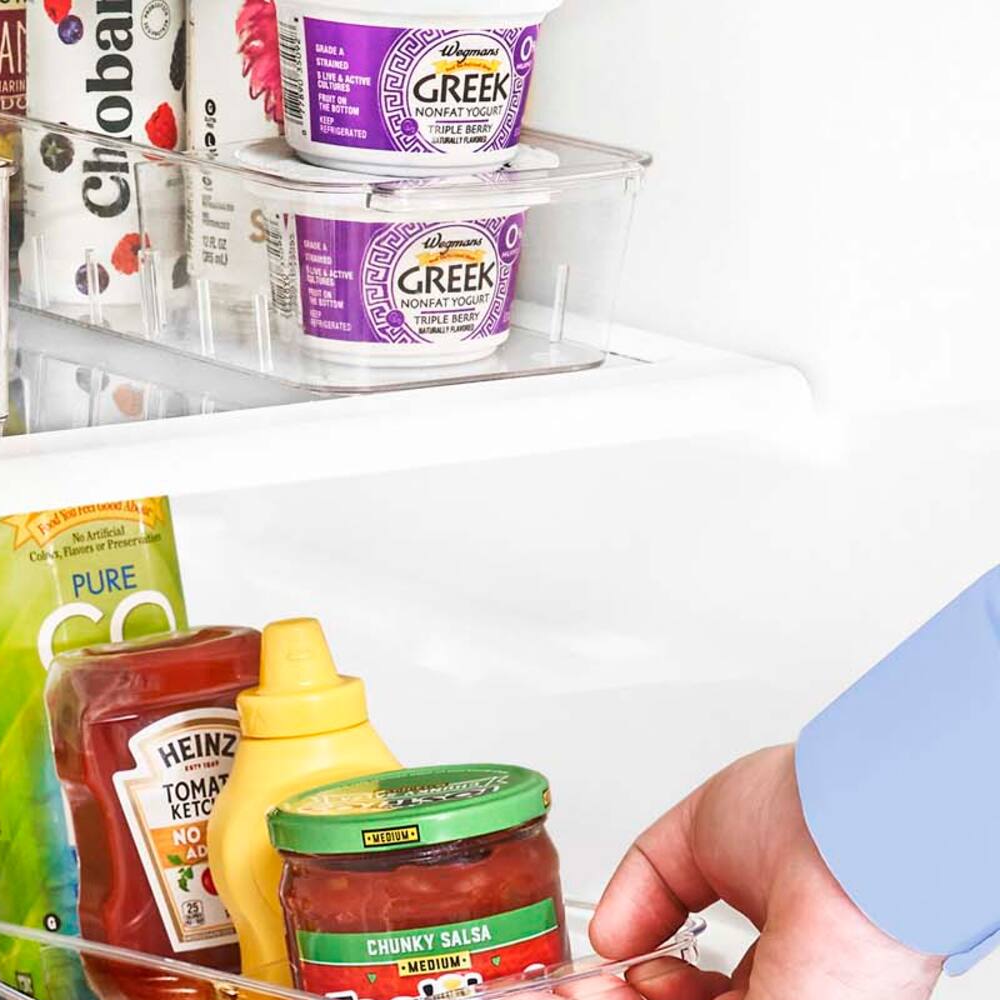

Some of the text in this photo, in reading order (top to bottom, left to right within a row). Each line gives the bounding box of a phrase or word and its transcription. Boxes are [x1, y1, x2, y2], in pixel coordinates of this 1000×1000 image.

[440, 41, 499, 63] Wegmans
[345, 75, 371, 87] ACTIVE
[413, 72, 510, 103] GREEK
[331, 104, 360, 116] BOTTOM
[415, 105, 503, 118] NONFAT YOGURT
[429, 124, 493, 135] TRIPLE BERRY
[424, 233, 483, 256] Wegmans
[397, 260, 497, 295] GREEK
[400, 293, 490, 309] NONFAT YOGURT
[414, 312, 480, 325] TRIPLE BERRY
[72, 532, 85, 544] No
[72, 564, 138, 598] PURE
[158, 732, 238, 768] HEINZ
[171, 798, 215, 820] KETC
[172, 826, 200, 846] NO
[373, 831, 410, 843] MEDIUM
[367, 925, 492, 957] CHUNKY SALSA
[408, 956, 461, 973] MEDIUM
